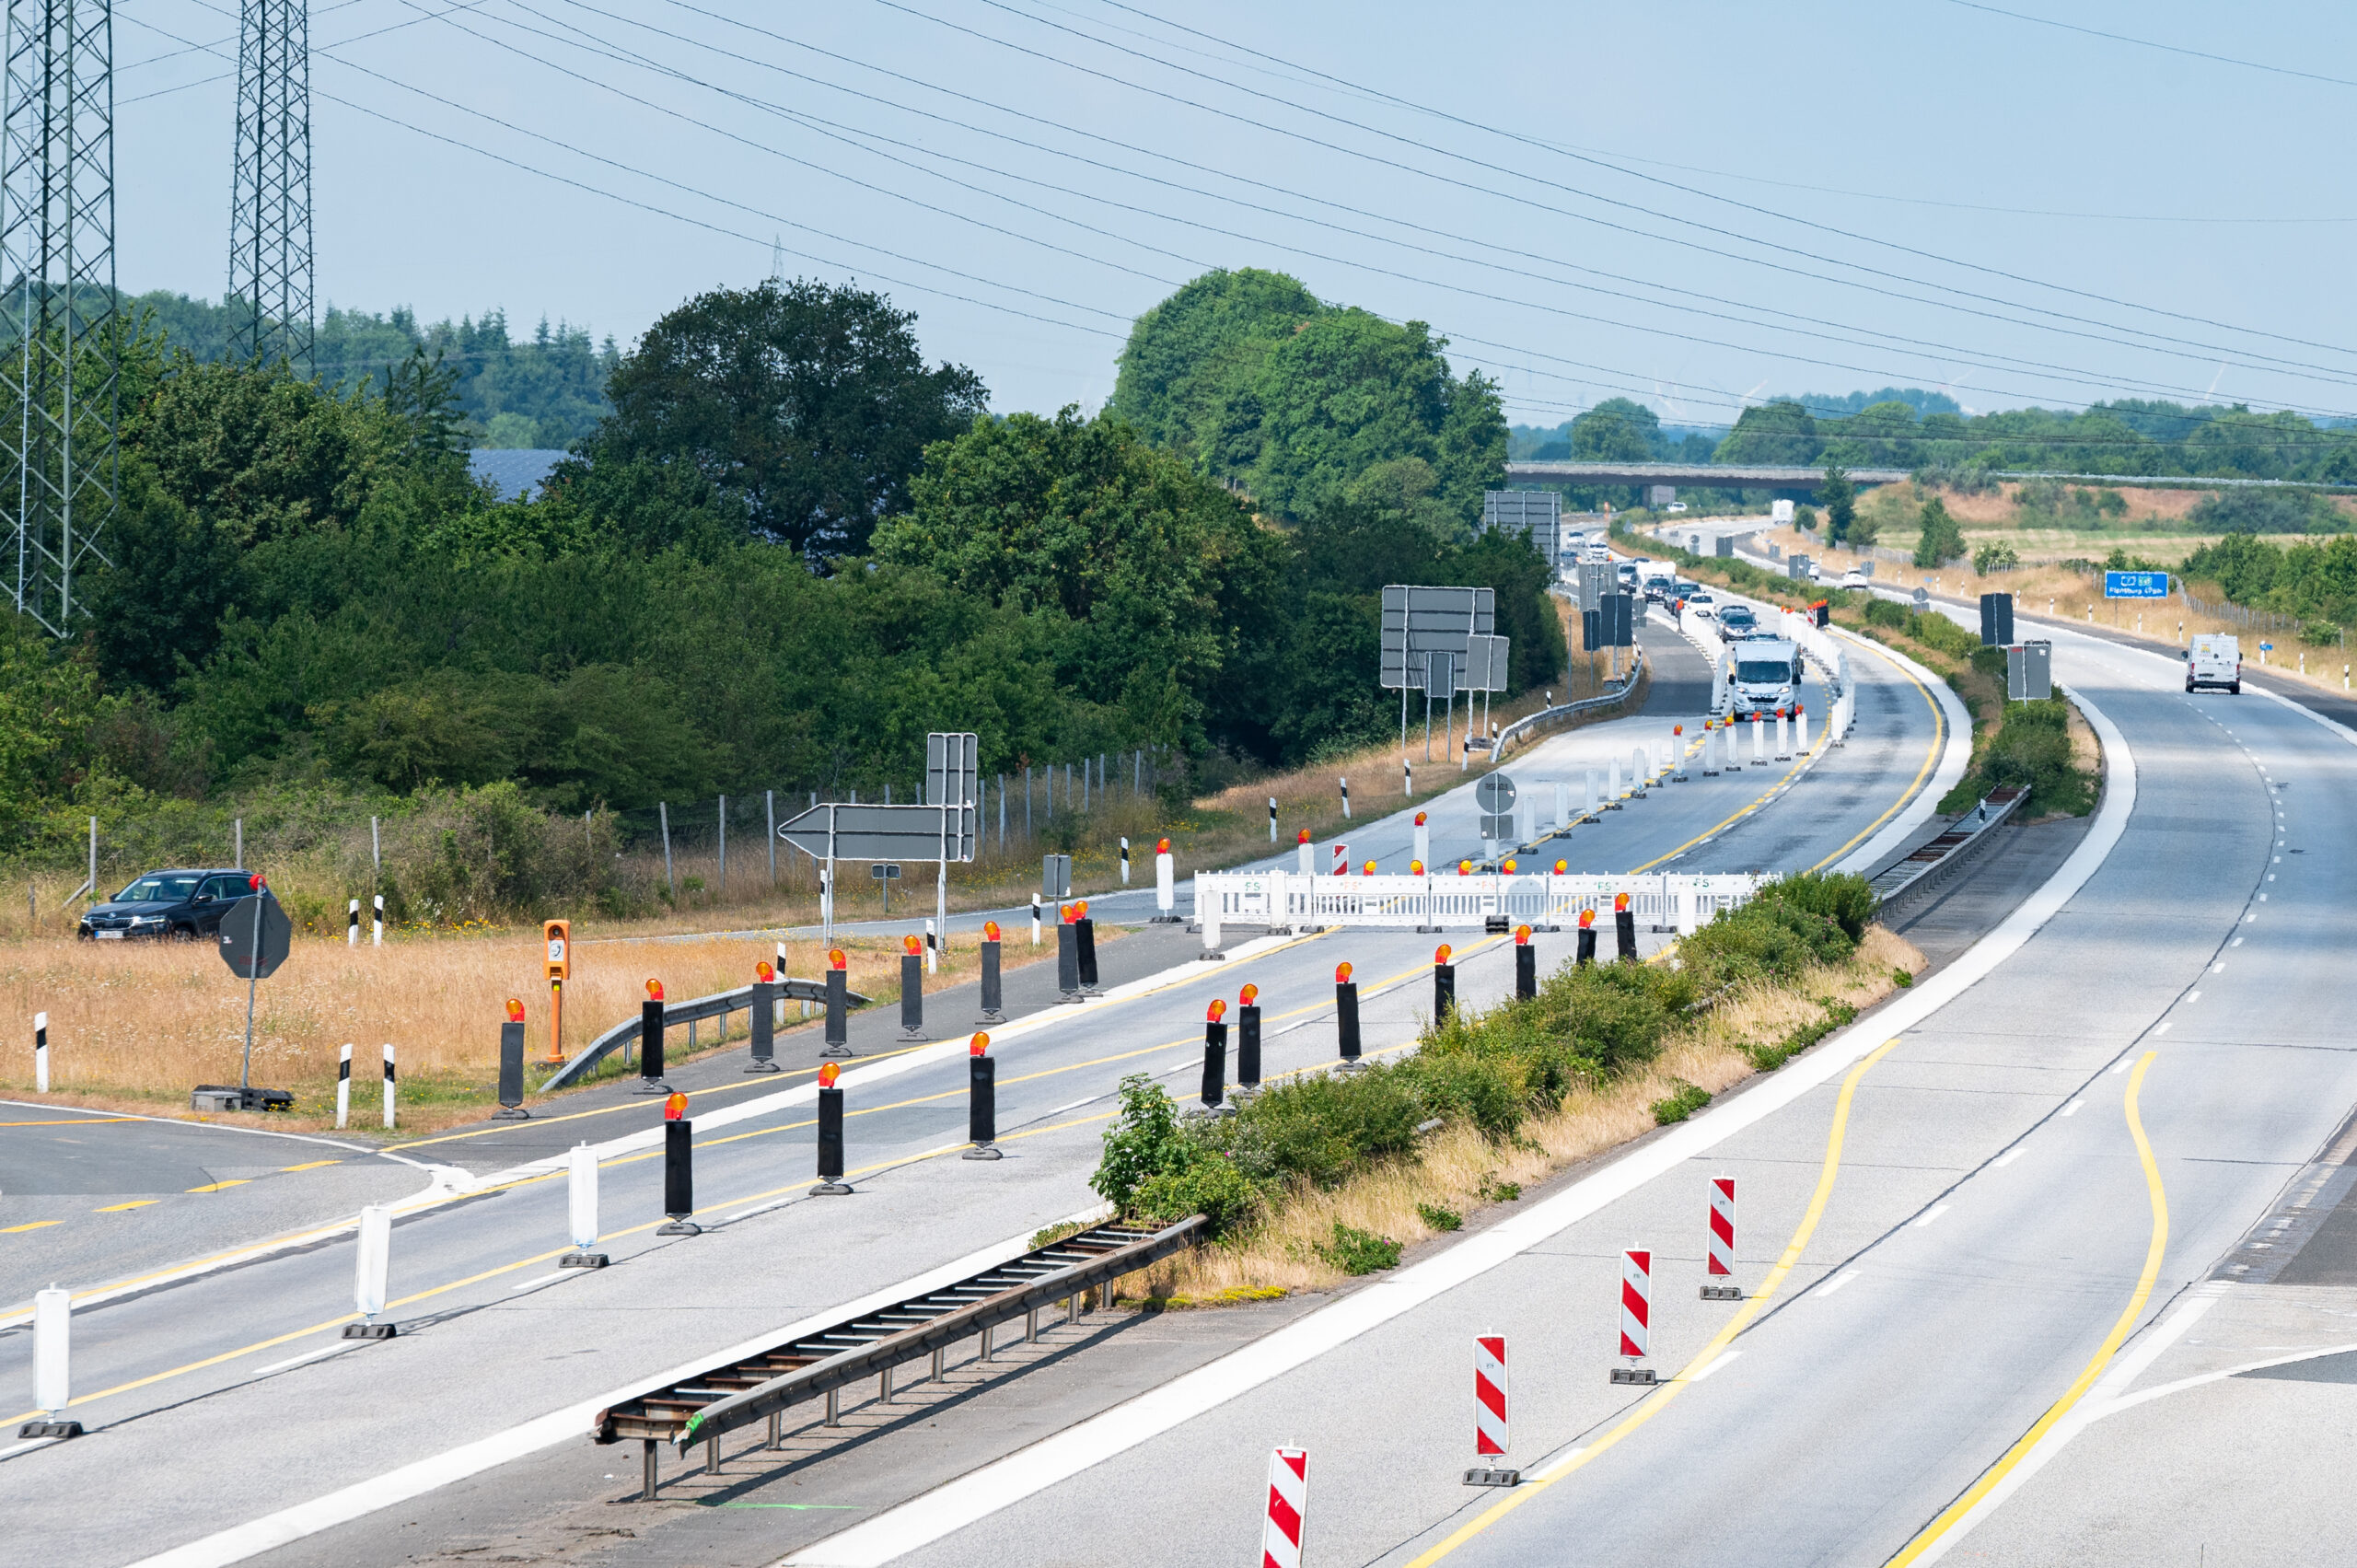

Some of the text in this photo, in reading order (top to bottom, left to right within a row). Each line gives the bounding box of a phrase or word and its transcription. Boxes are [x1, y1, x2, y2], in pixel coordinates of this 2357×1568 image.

[1245, 881, 1260, 891] FS
[1343, 881, 1358, 891] FS
[1597, 881, 1612, 891] FS
[1695, 877, 1710, 888] FS
